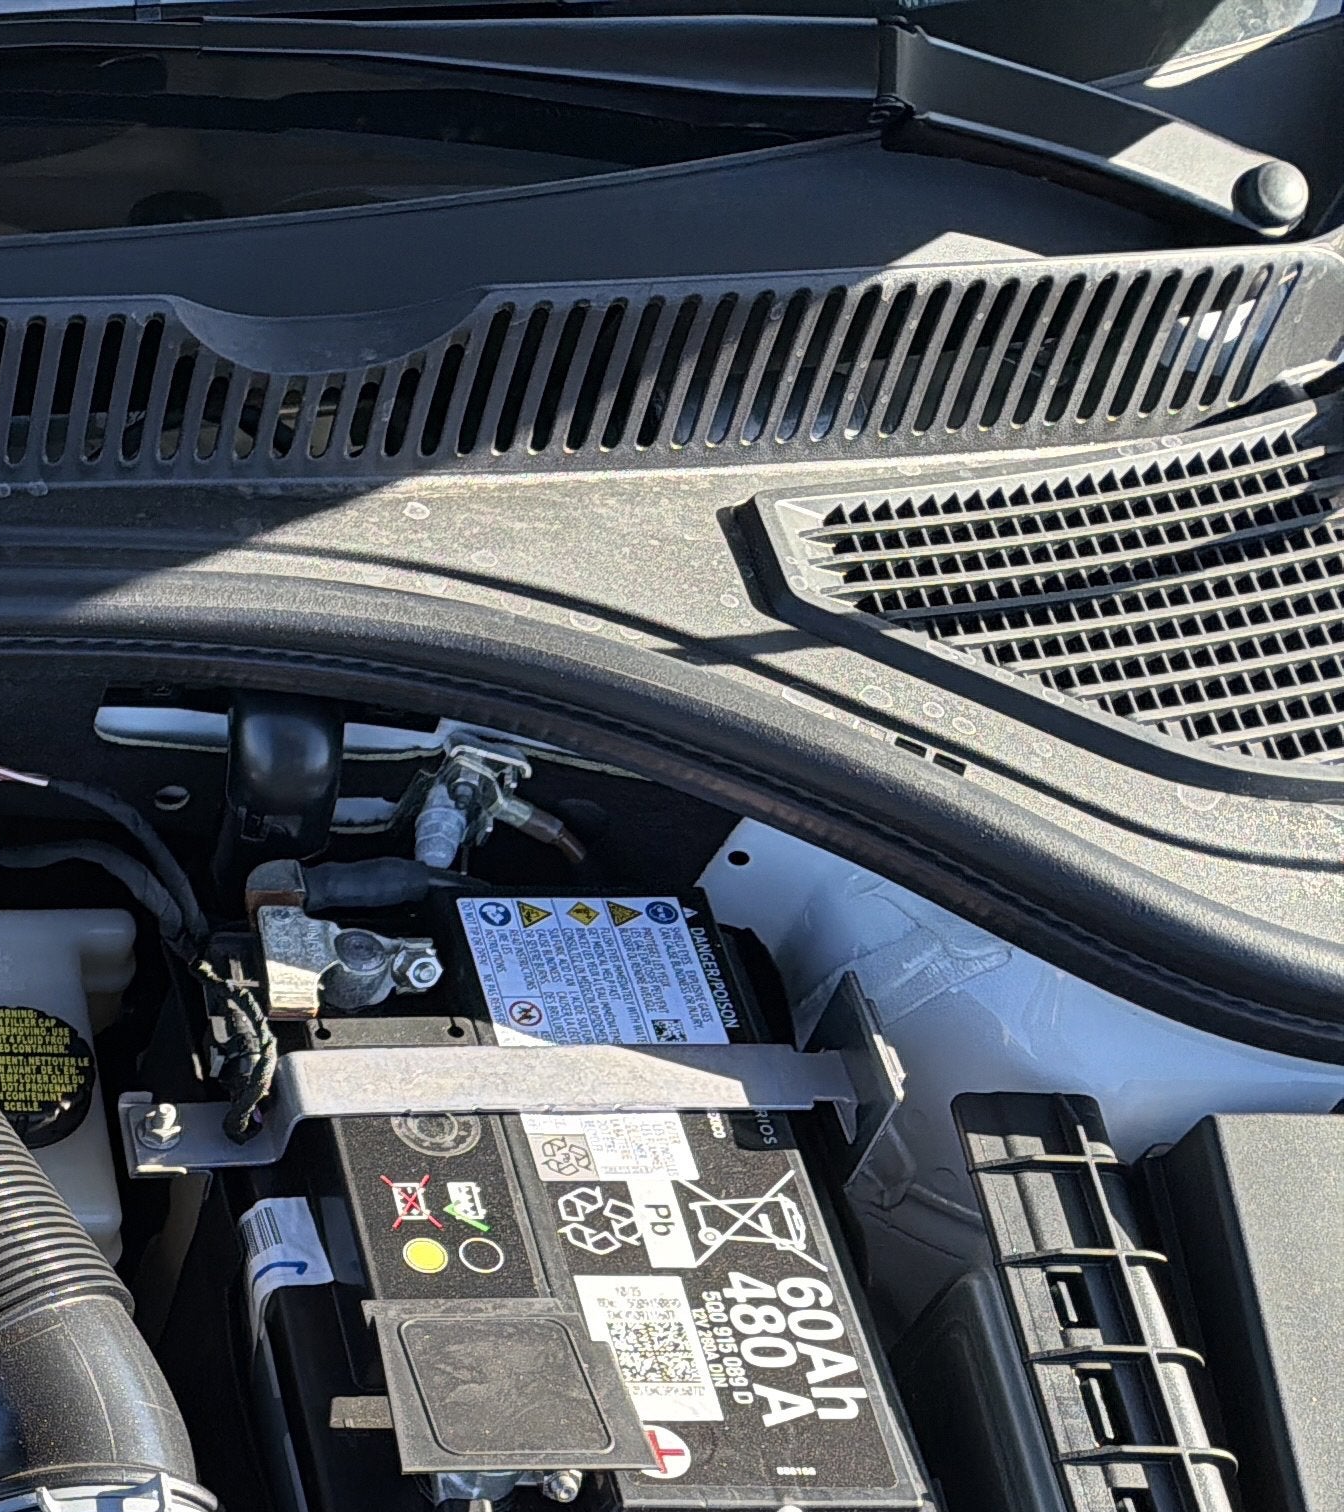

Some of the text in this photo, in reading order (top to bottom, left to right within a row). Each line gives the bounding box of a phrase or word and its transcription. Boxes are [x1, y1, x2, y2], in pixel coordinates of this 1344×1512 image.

[689, 927, 740, 1028] DANGER/POISON
[5, 1018, 36, 1026] FILLER
[38, 1018, 56, 1026] CAP
[53, 1028, 70, 1036] USE
[17, 1036, 43, 1044] FLUID
[46, 1037, 70, 1045] FROM
[12, 1045, 69, 1053] CONTAINER.
[28, 1056, 76, 1066] NETTOYER
[78, 1057, 90, 1066] LE
[7, 1065, 37, 1074] AVANT
[41, 1066, 53, 1074] DE
[52, 1075, 69, 1083] QUE
[26, 1083, 78, 1092] PROVENANT
[6, 1092, 62, 1101] CONTENANT
[644, 1204, 675, 1236] Pb
[718, 1272, 798, 1367] 480
[689, 1307, 710, 1326] 12V
[707, 1363, 729, 1387] DIN
[699, 1291, 754, 1404] 5Q0 915 089 D
[777, 1278, 868, 1419] 60Ah
[753, 1382, 818, 1427] A
